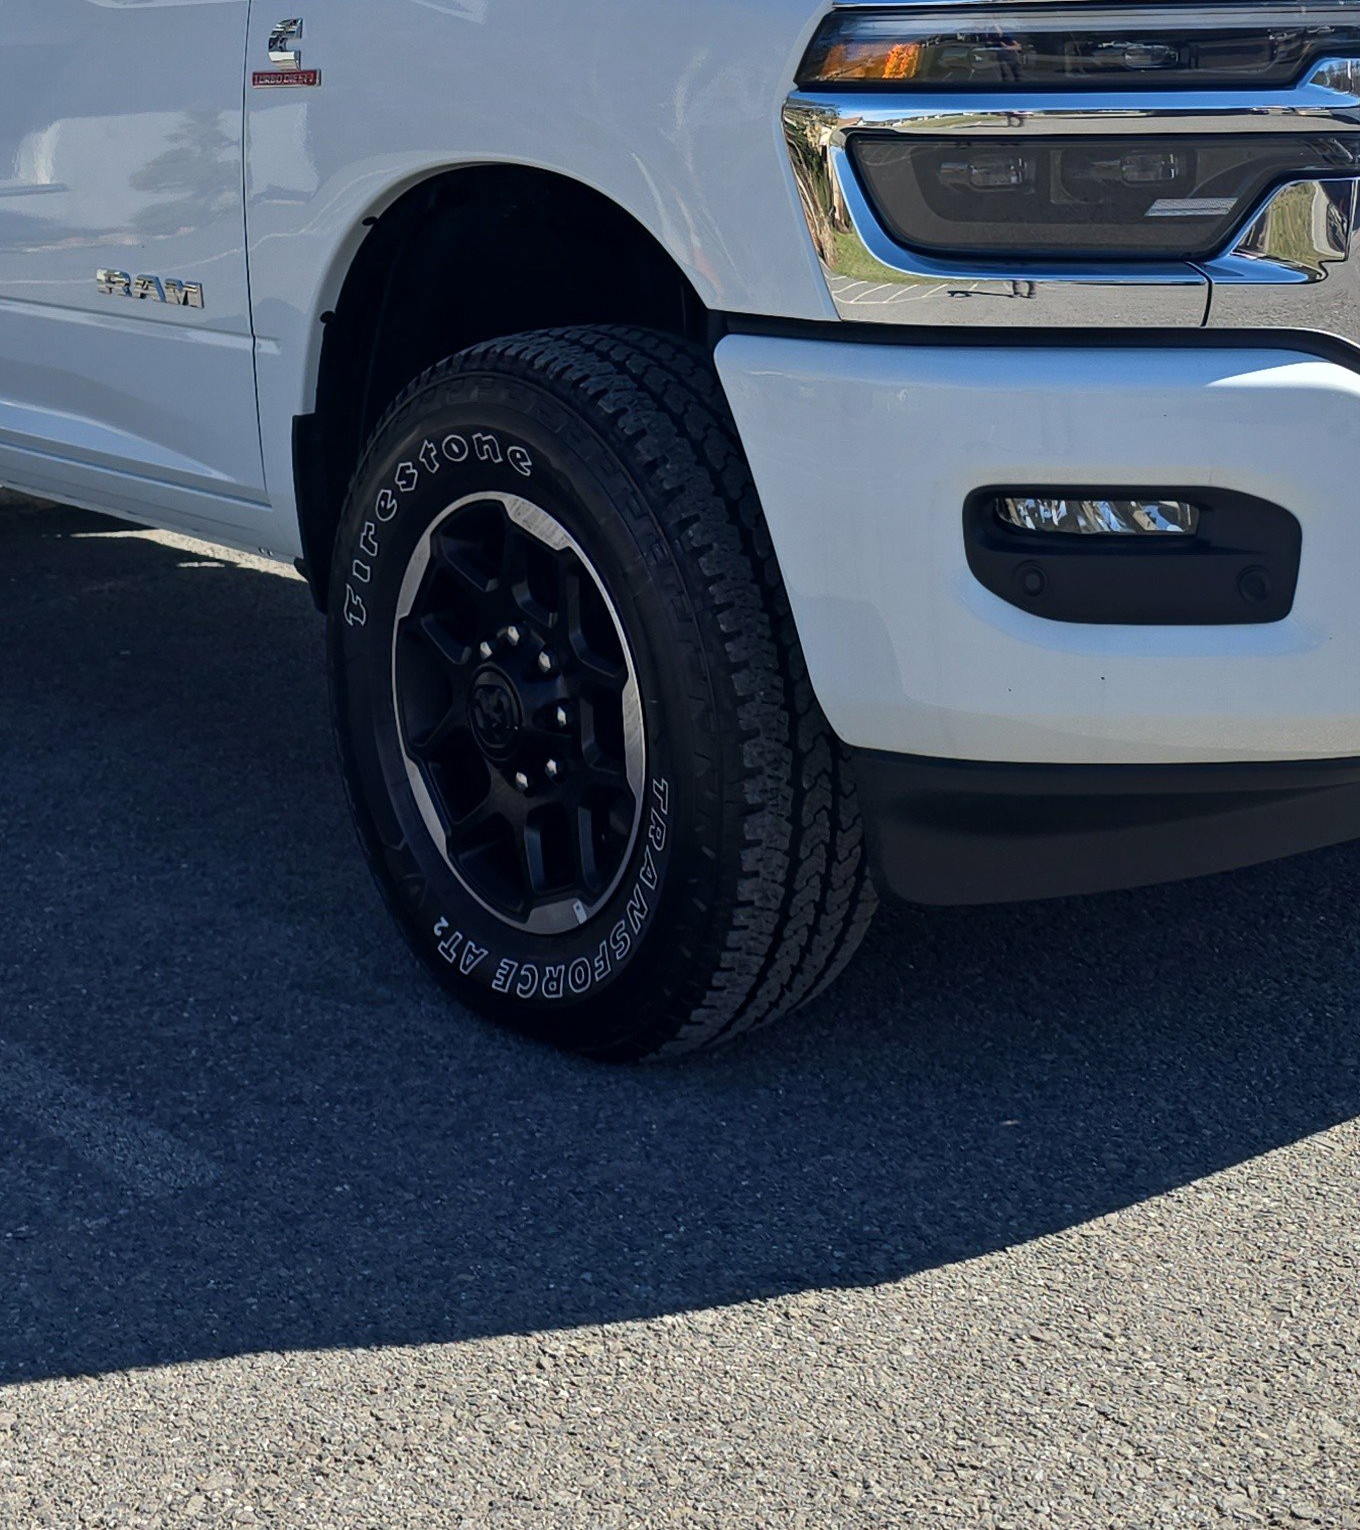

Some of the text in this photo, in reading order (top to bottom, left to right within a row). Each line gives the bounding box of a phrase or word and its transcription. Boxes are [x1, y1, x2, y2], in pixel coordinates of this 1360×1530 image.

[96, 269, 204, 309] RAM
[343, 432, 533, 627] Firestone
[491, 777, 669, 999] TRANSFORCE
